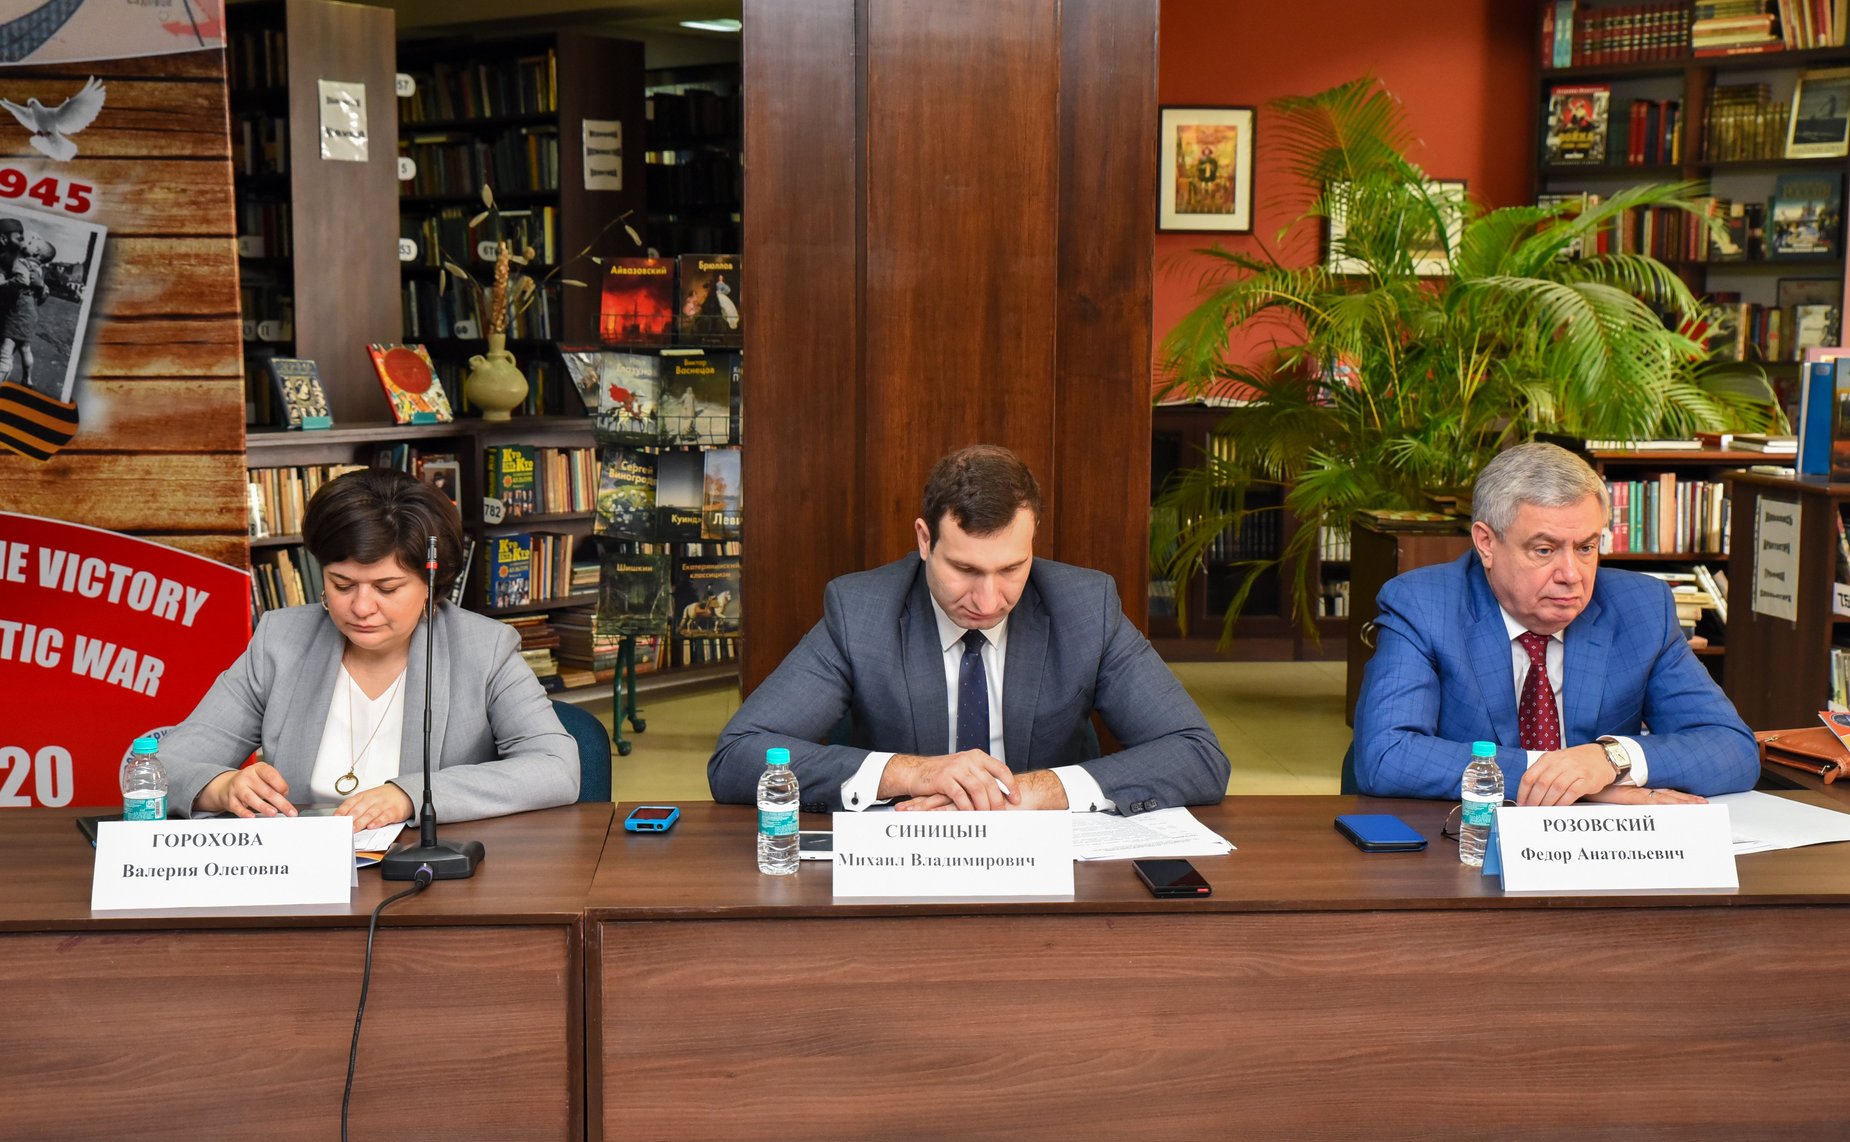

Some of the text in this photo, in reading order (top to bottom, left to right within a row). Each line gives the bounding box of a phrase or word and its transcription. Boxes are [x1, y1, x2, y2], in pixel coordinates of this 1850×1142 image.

[0, 168, 93, 214] 945
[610, 265, 667, 275] Айвазовский
[698, 260, 733, 272] Брюллов
[675, 365, 716, 376] Васнецов
[684, 359, 707, 368] Виктор
[502, 448, 521, 462] Кто
[516, 457, 534, 471] Кто
[621, 460, 654, 475] Сергей
[484, 503, 501, 519] 782
[499, 538, 518, 552] Кто
[512, 547, 530, 562] Кто
[617, 563, 653, 572] Шишкин
[39, 547, 210, 628] VICTORY
[0, 619, 165, 698] TIC WAR
[0, 745, 74, 808] 20
[1543, 815, 1656, 832] РОЗОВСКИЙ
[152, 832, 263, 848] ГОРОХОВА
[885, 824, 987, 840] СИНИЦЫН
[839, 853, 1035, 870] Михаил Владимирович
[1521, 847, 1685, 864] Федор Анатольевич
[122, 862, 289, 881] Валерия Олеговна
